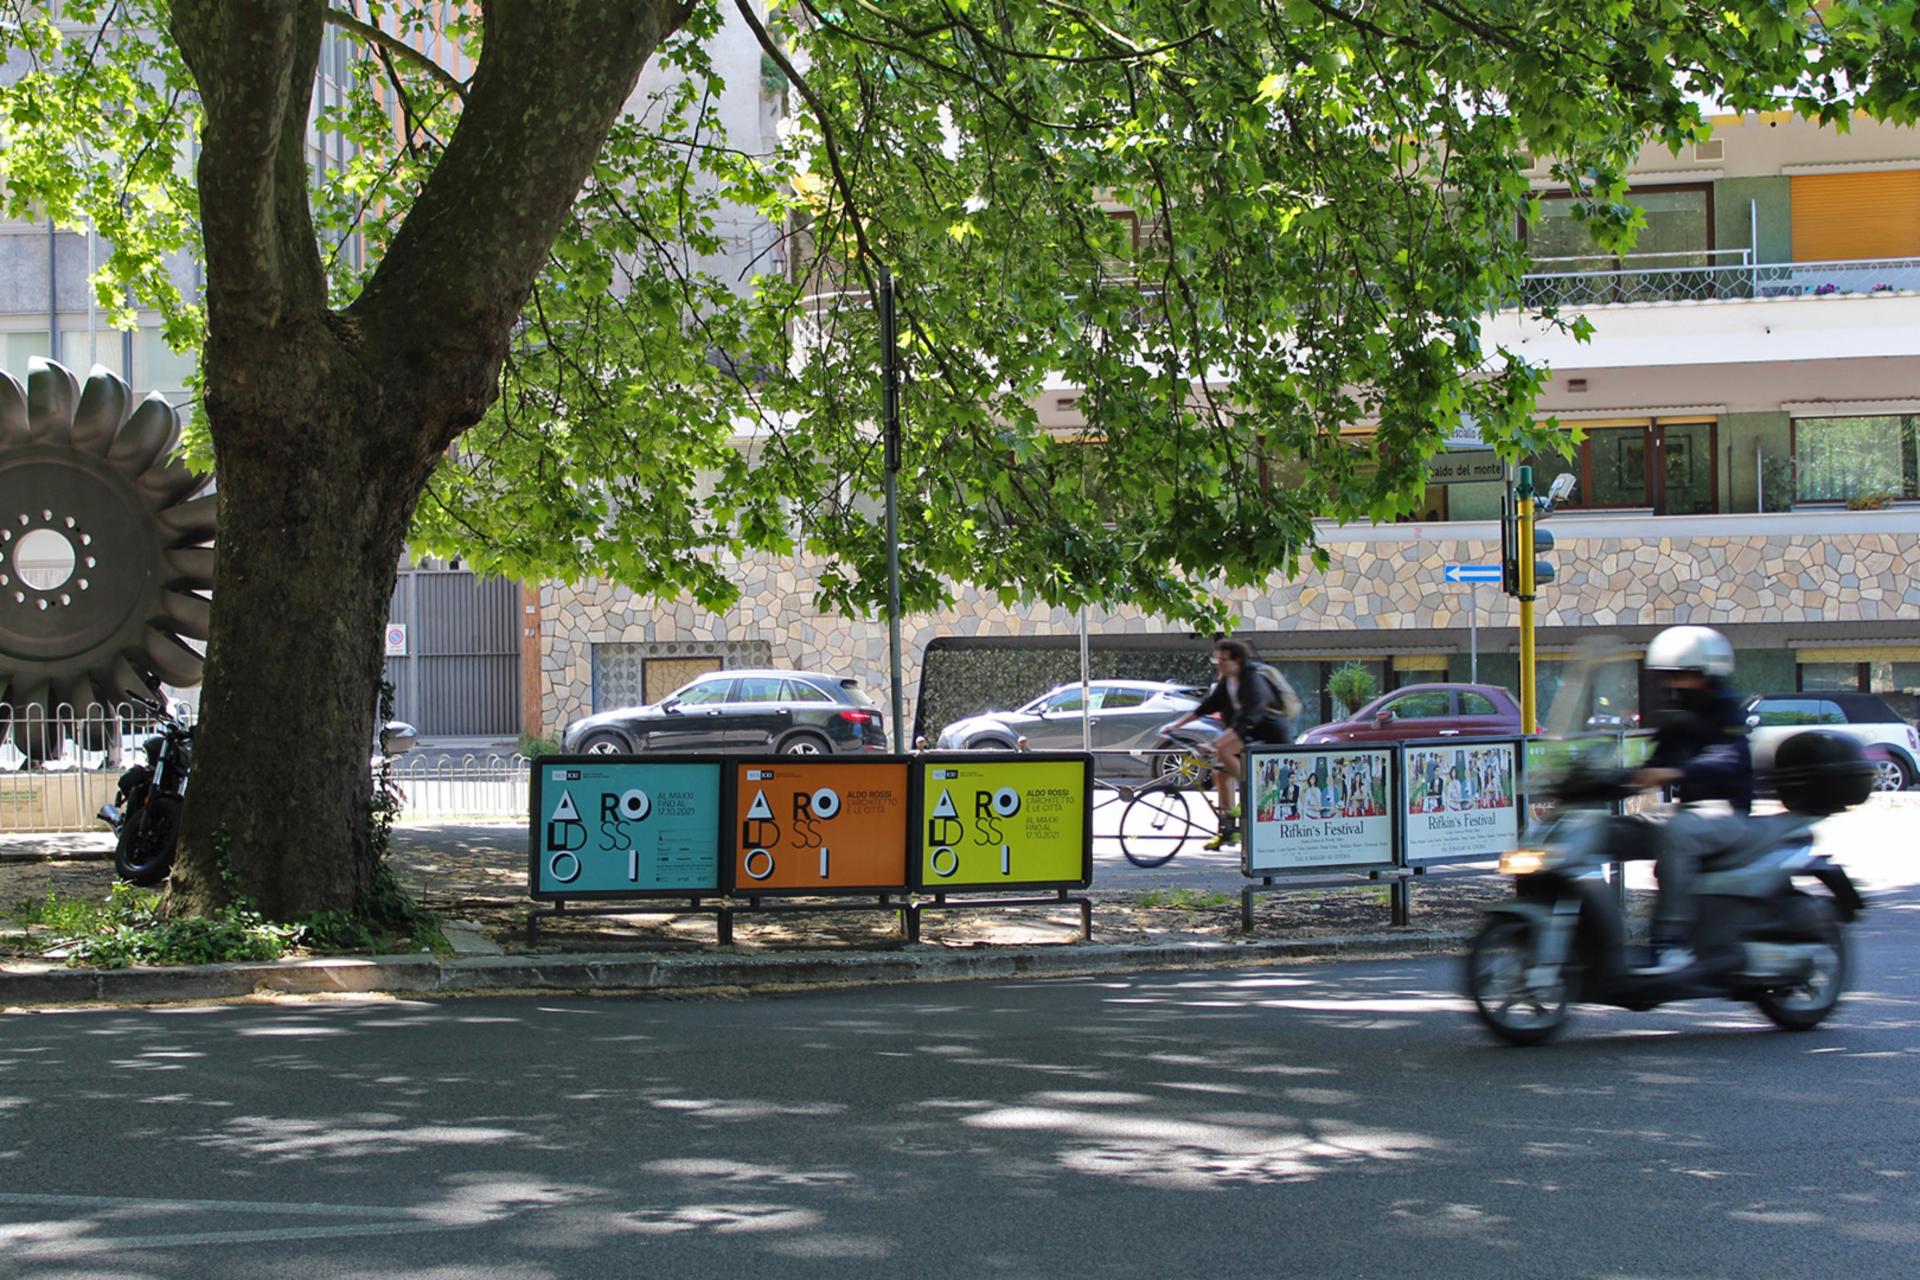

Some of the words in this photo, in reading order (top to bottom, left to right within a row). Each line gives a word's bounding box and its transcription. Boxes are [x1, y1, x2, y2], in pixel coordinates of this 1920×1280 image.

[1457, 465, 1470, 476] del
[1474, 464, 1501, 475] monte
[657, 792, 668, 800] AL
[847, 791, 867, 799] ALDO
[1026, 789, 1046, 797] ALDO
[1428, 815, 1462, 830] Rifkin's
[1464, 812, 1496, 827] Festival
[1280, 823, 1320, 839] Rifkin's
[1324, 821, 1364, 836] Festival
